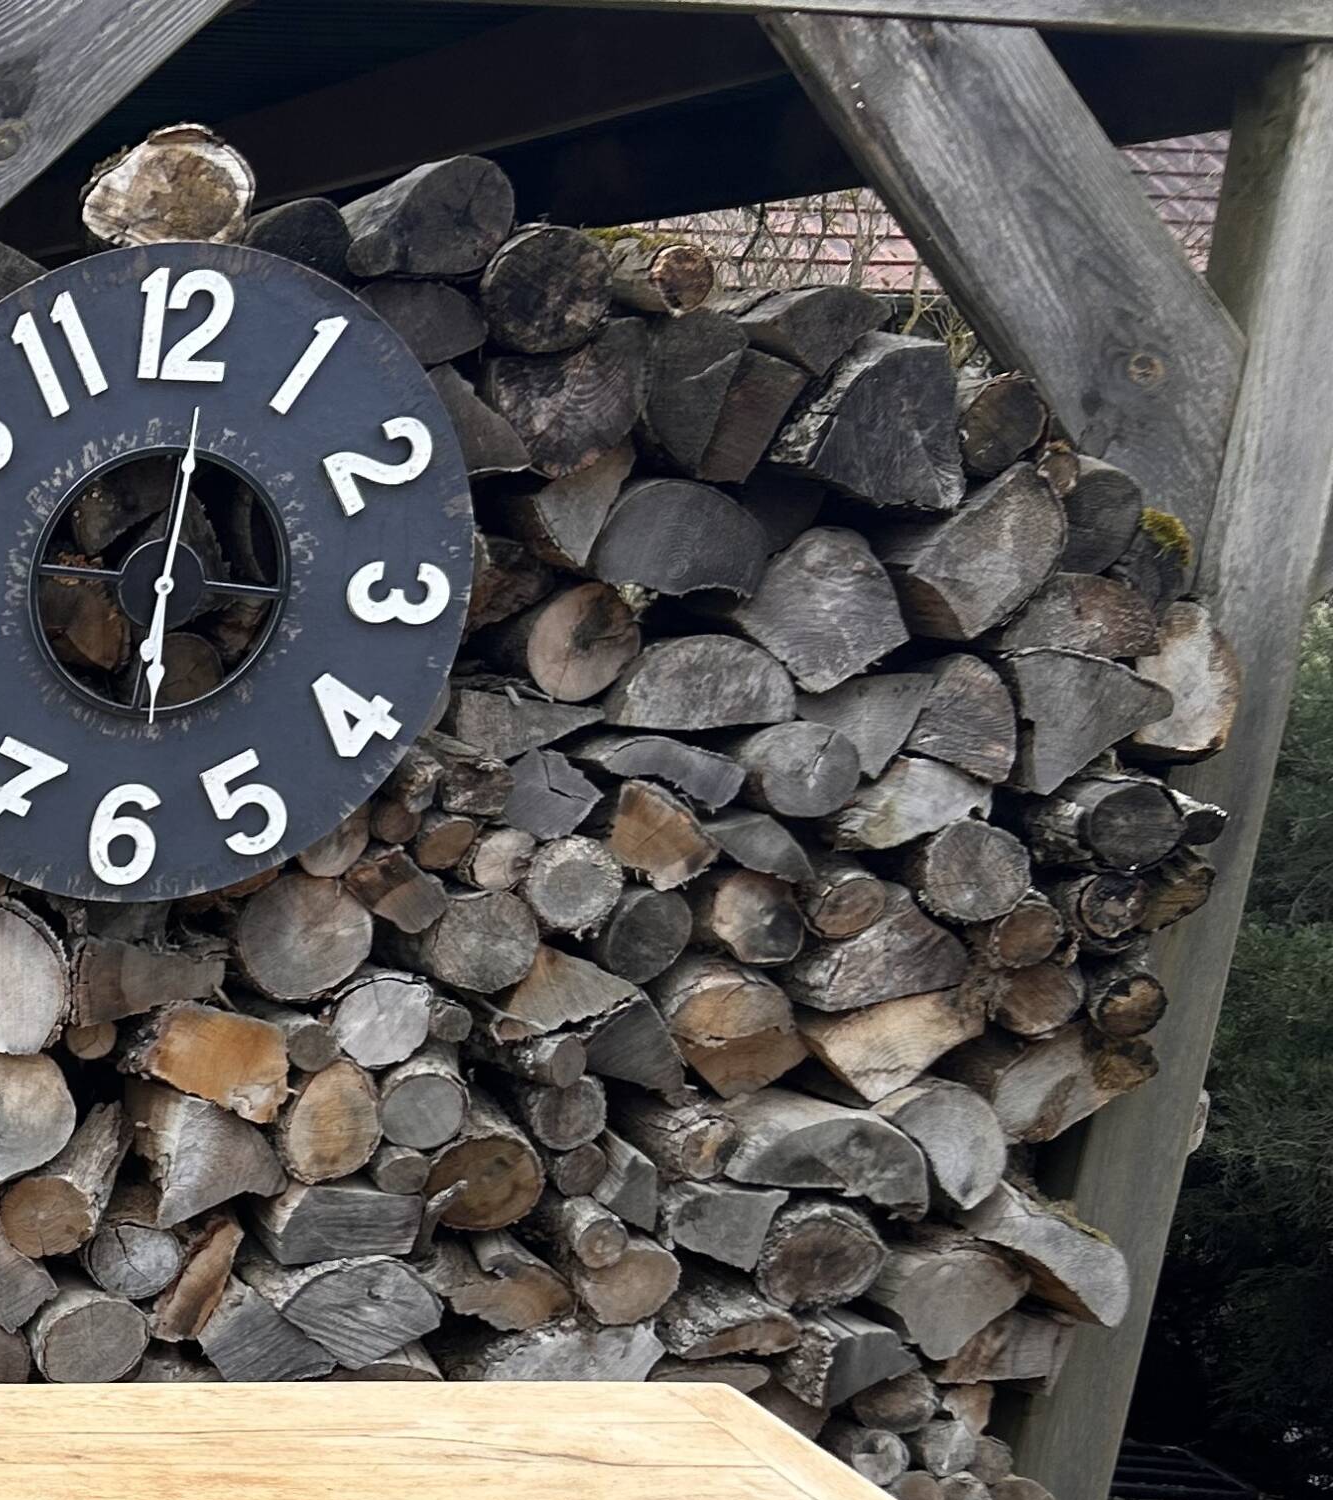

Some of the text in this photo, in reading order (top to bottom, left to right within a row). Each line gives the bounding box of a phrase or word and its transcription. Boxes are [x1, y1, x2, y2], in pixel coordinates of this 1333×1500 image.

[12, 291, 108, 417] 11
[138, 268, 234, 381] 12
[269, 316, 348, 414] 1
[323, 417, 432, 516] 2
[347, 562, 450, 624] 3
[312, 673, 402, 757] 4
[89, 784, 160, 885] 6
[200, 749, 287, 854] 5
